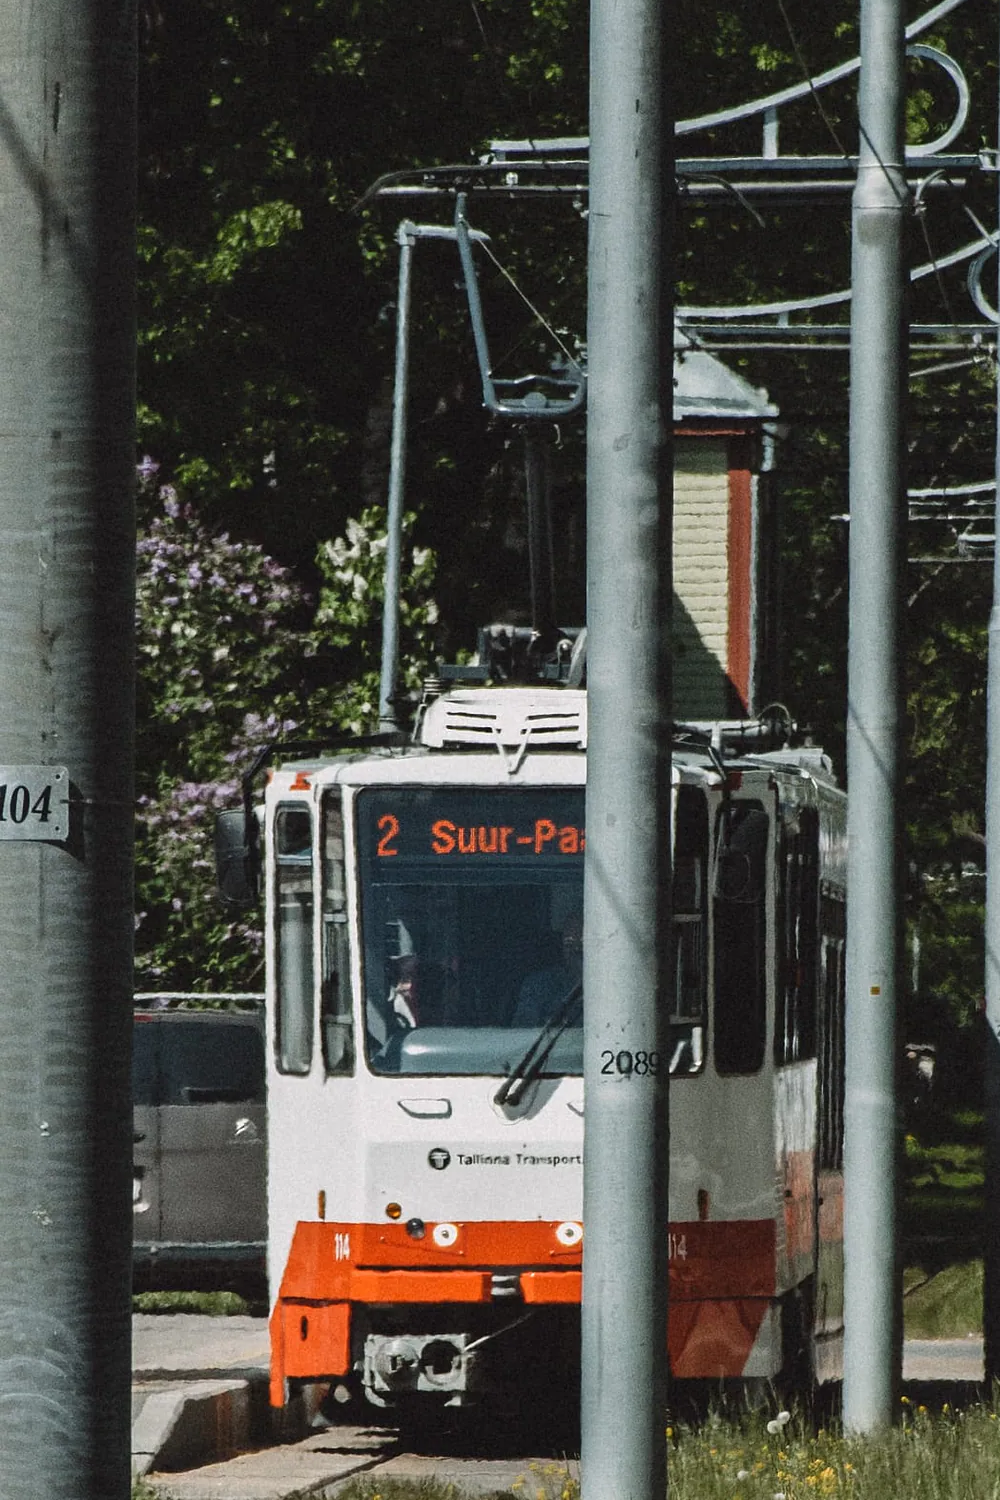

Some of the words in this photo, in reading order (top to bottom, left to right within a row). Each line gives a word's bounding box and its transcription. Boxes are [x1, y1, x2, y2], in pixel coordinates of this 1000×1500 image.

[377, 813, 399, 857] 2
[431, 819, 585, 854] Suur-Pa
[457, 1154, 510, 1166] Tallinna
[335, 1232, 350, 1261] 114
